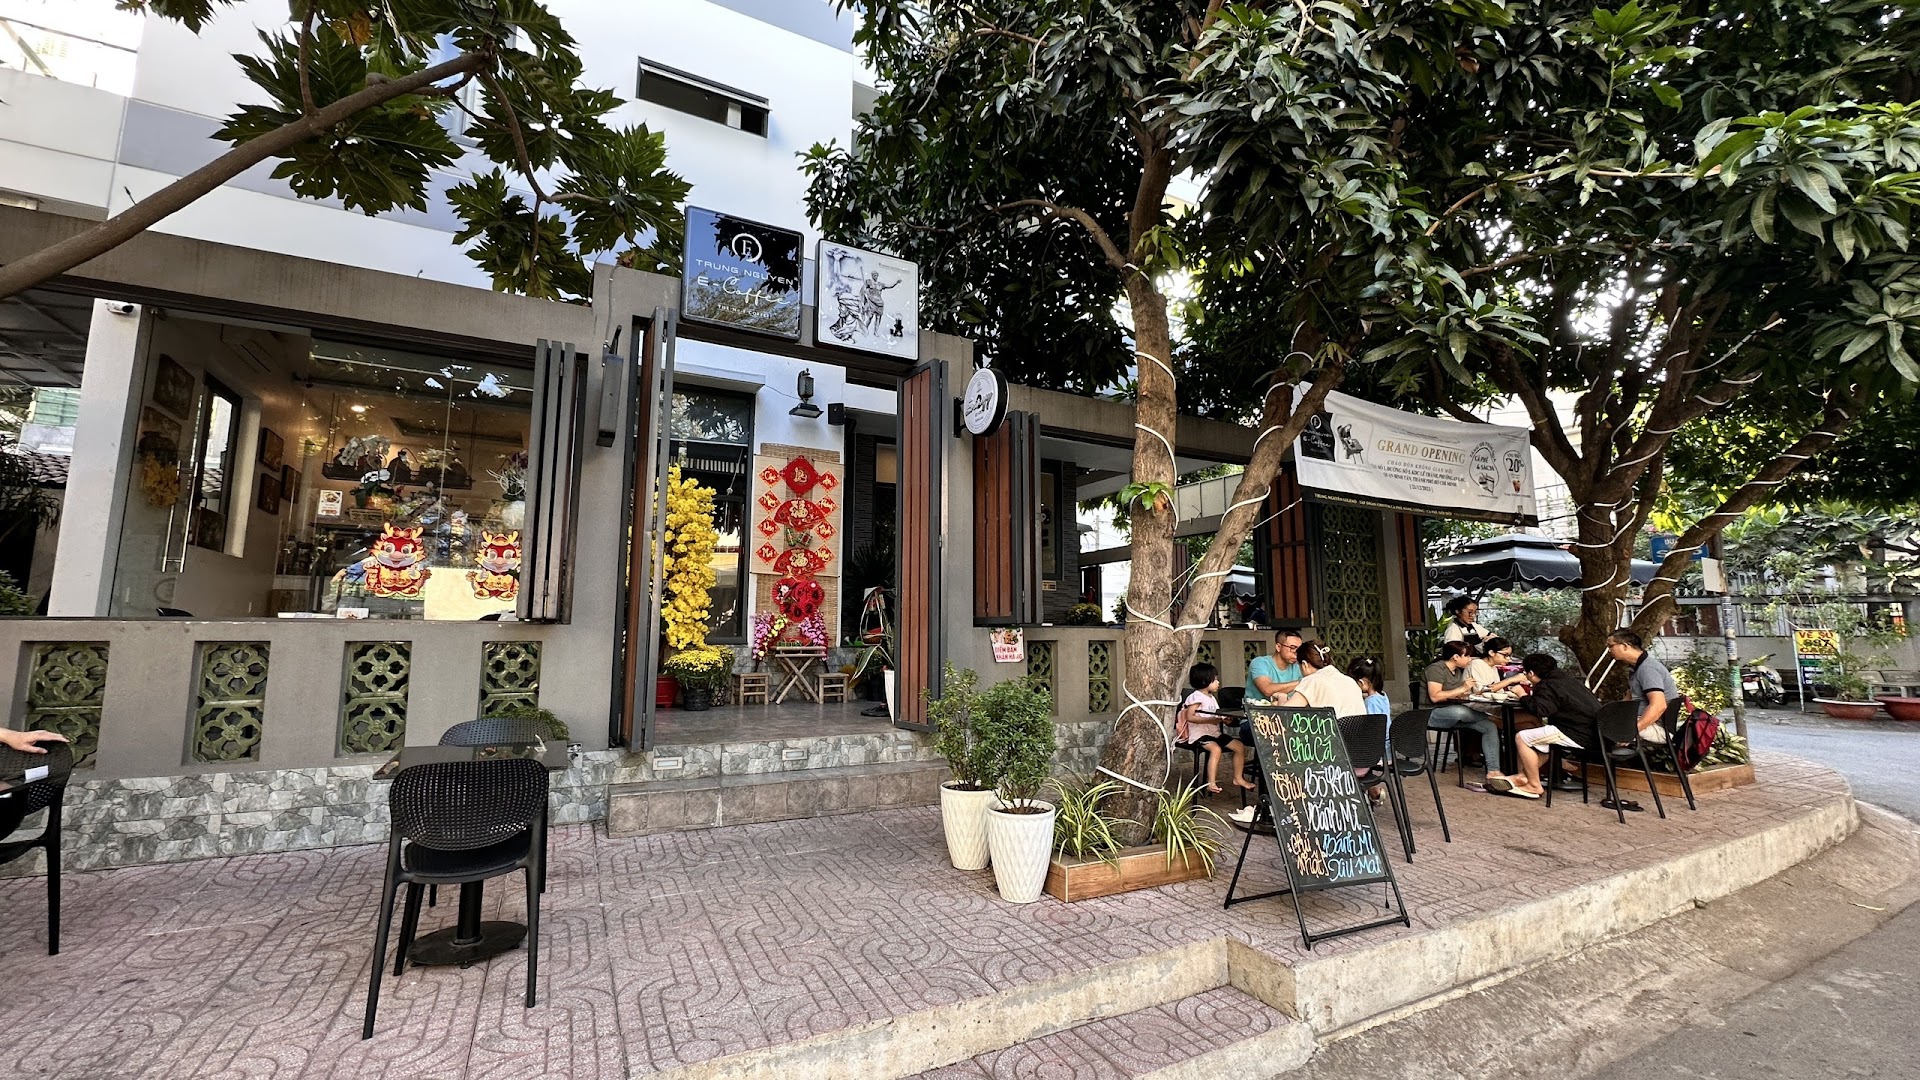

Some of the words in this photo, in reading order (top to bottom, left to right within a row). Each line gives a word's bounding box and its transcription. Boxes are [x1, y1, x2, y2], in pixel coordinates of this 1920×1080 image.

[695, 259, 739, 274] TRUNG
[1377, 439, 1418, 456] GRAND
[1421, 446, 1466, 464] OPENING
[1290, 712, 1335, 736] Bún
